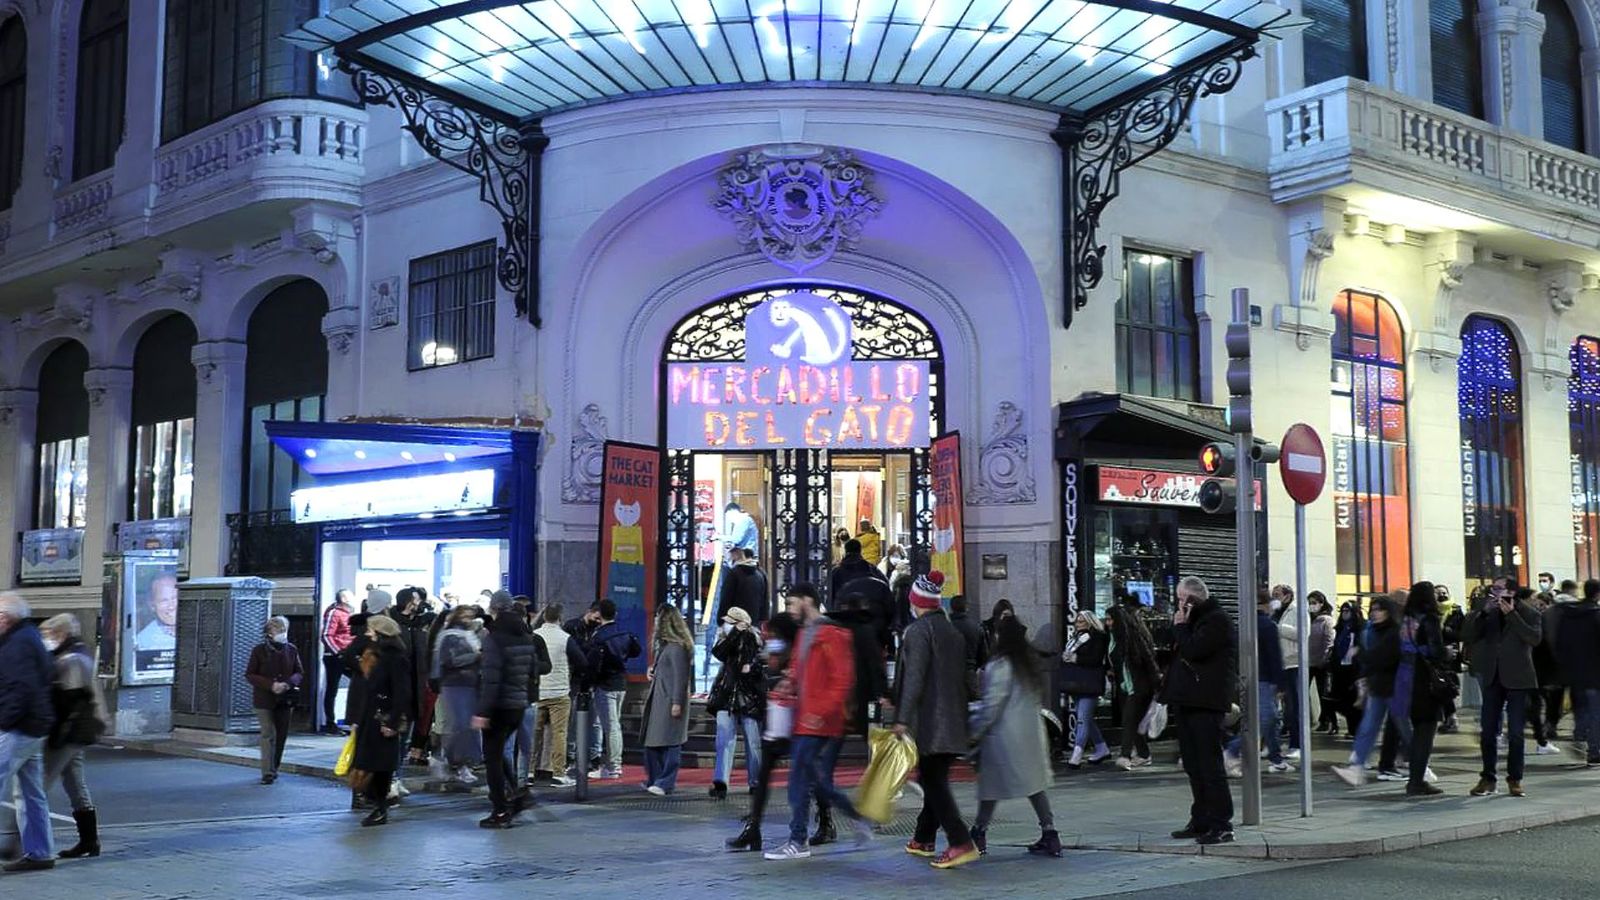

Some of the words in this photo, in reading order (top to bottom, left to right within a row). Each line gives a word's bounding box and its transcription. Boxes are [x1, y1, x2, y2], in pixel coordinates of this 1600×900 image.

[672, 364, 921, 404] MERCADILLO
[705, 410, 786, 446] DEL
[805, 404, 915, 446] GATO
[608, 473, 654, 489] MARKET
[611, 456, 632, 472] THE
[633, 459, 653, 474] CAT
[1462, 439, 1476, 536] kutxabank
[1065, 463, 1078, 622] SOUVENIRS
